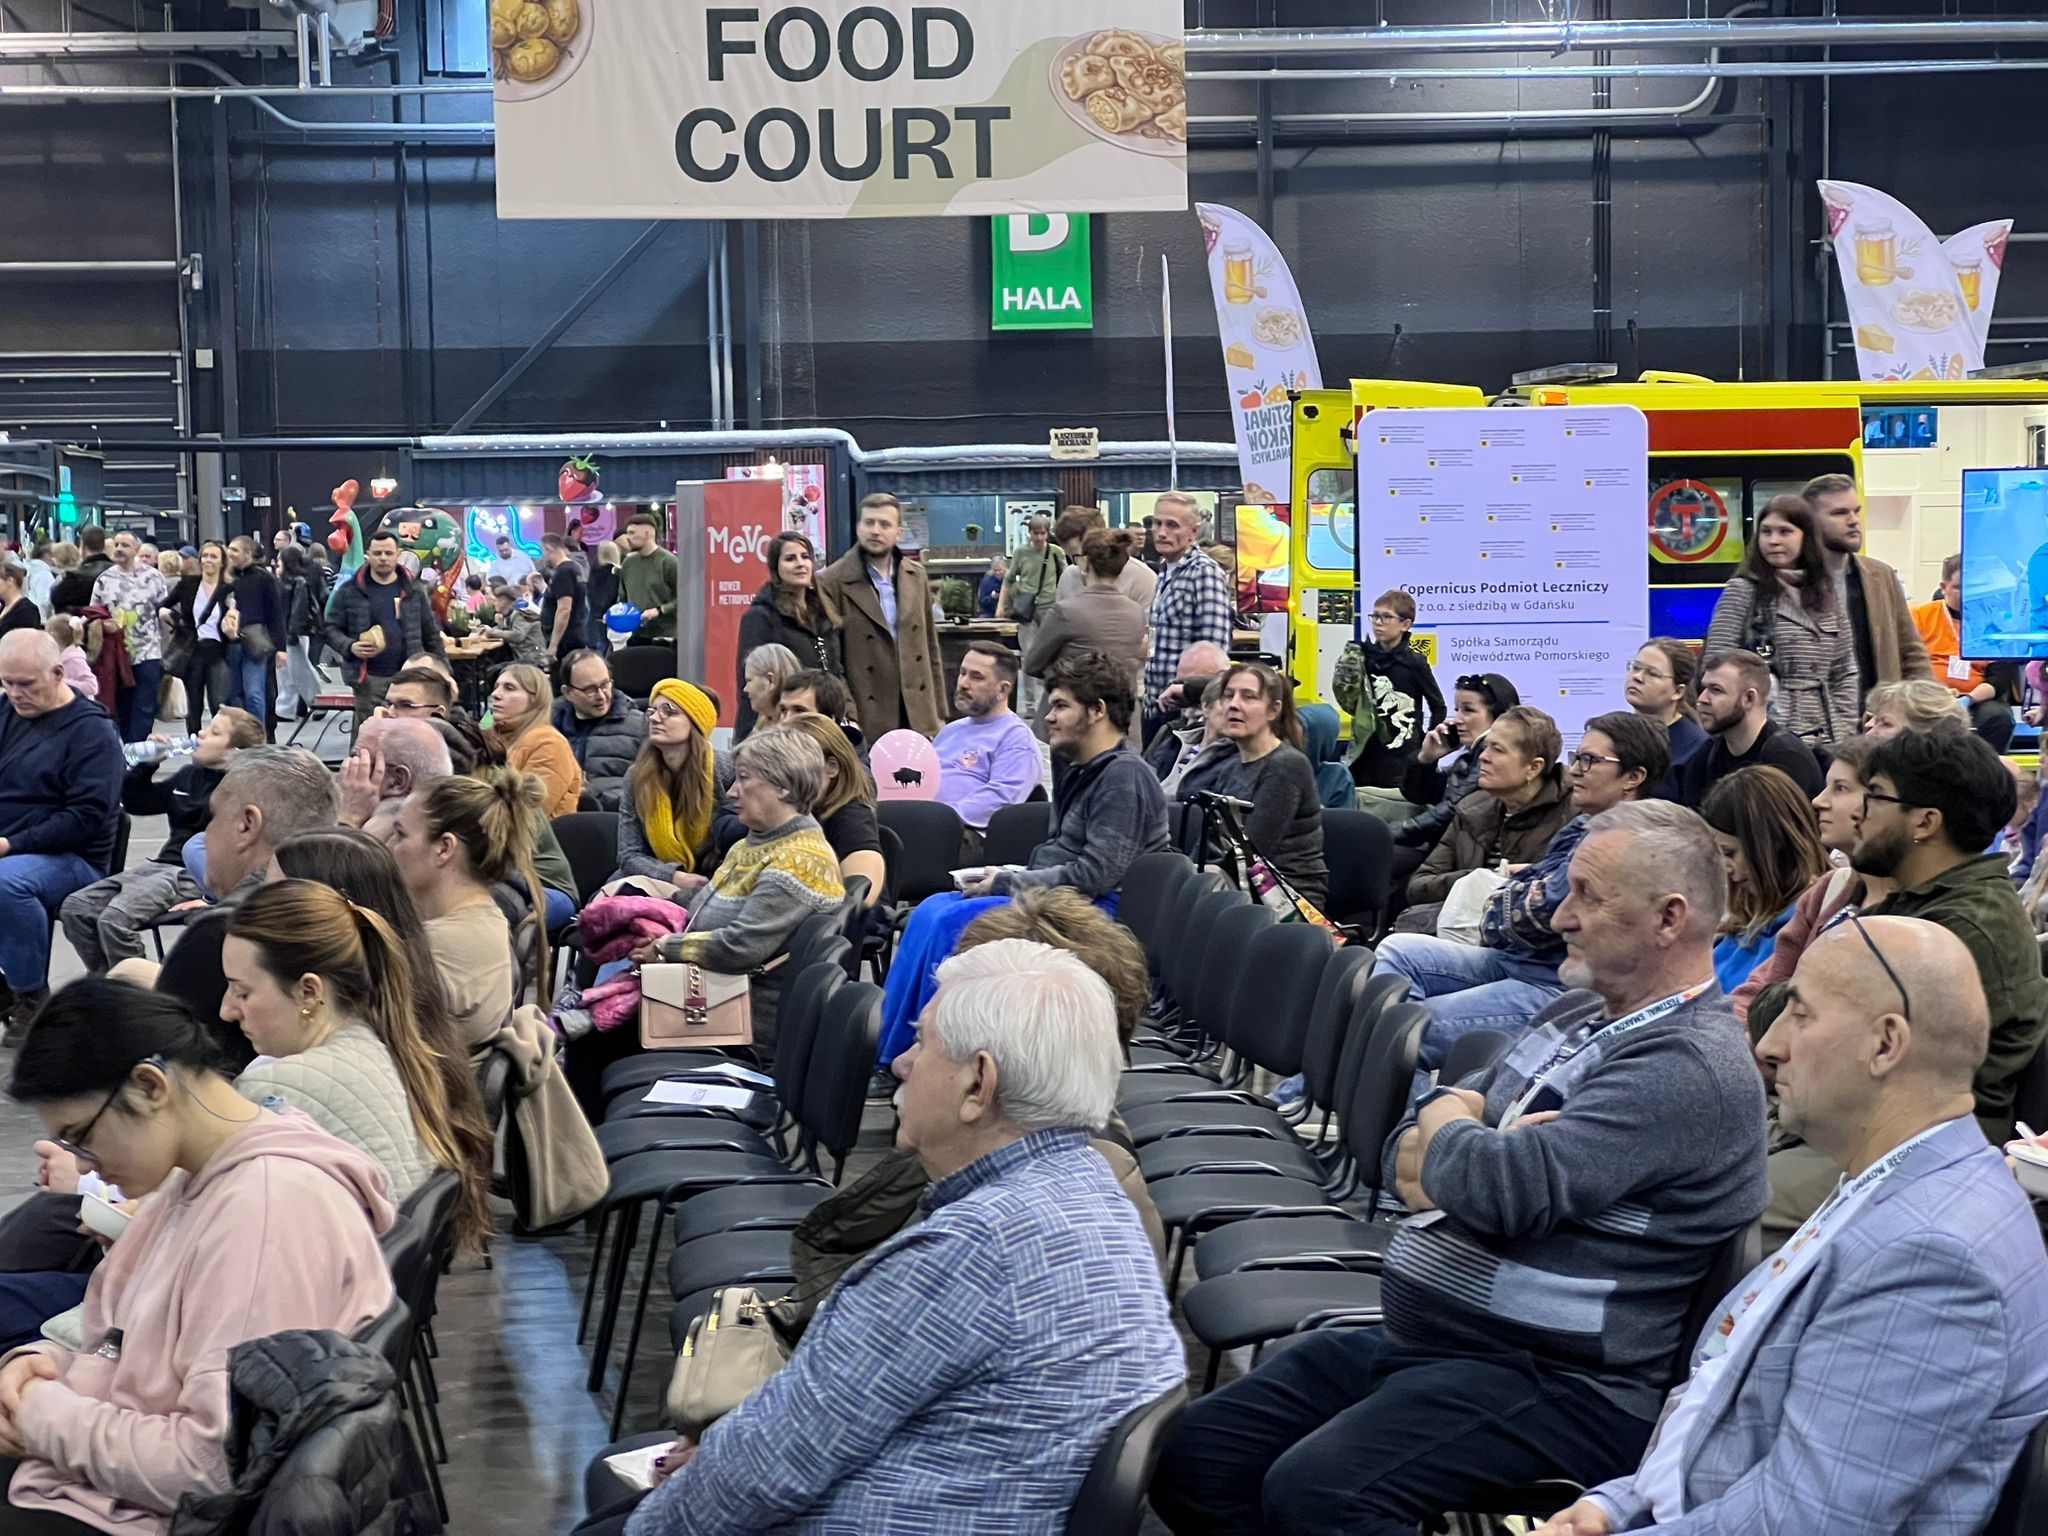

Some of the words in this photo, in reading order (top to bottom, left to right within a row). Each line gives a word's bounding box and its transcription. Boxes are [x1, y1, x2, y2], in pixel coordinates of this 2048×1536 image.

[706, 6, 974, 82] FOOD
[675, 106, 1011, 183] COURT
[1003, 286, 1082, 311] HALA
[1400, 582, 1477, 597] Copernicus
[1480, 580, 1539, 594] Podmiot
[1543, 580, 1609, 595] Leczniczy
[1418, 603, 1424, 612] z
[1426, 603, 1447, 612] o.o.
[1449, 603, 1455, 611] z
[1458, 600, 1507, 613] siedzibą
[1511, 602, 1520, 610] w
[1523, 599, 1575, 611] Gdańsku
[1451, 637, 1490, 651] Spółka
[1494, 635, 1559, 649] Samorządu
[1451, 651, 1531, 664] Województwa
[1534, 649, 1610, 663] Pomorskiego
